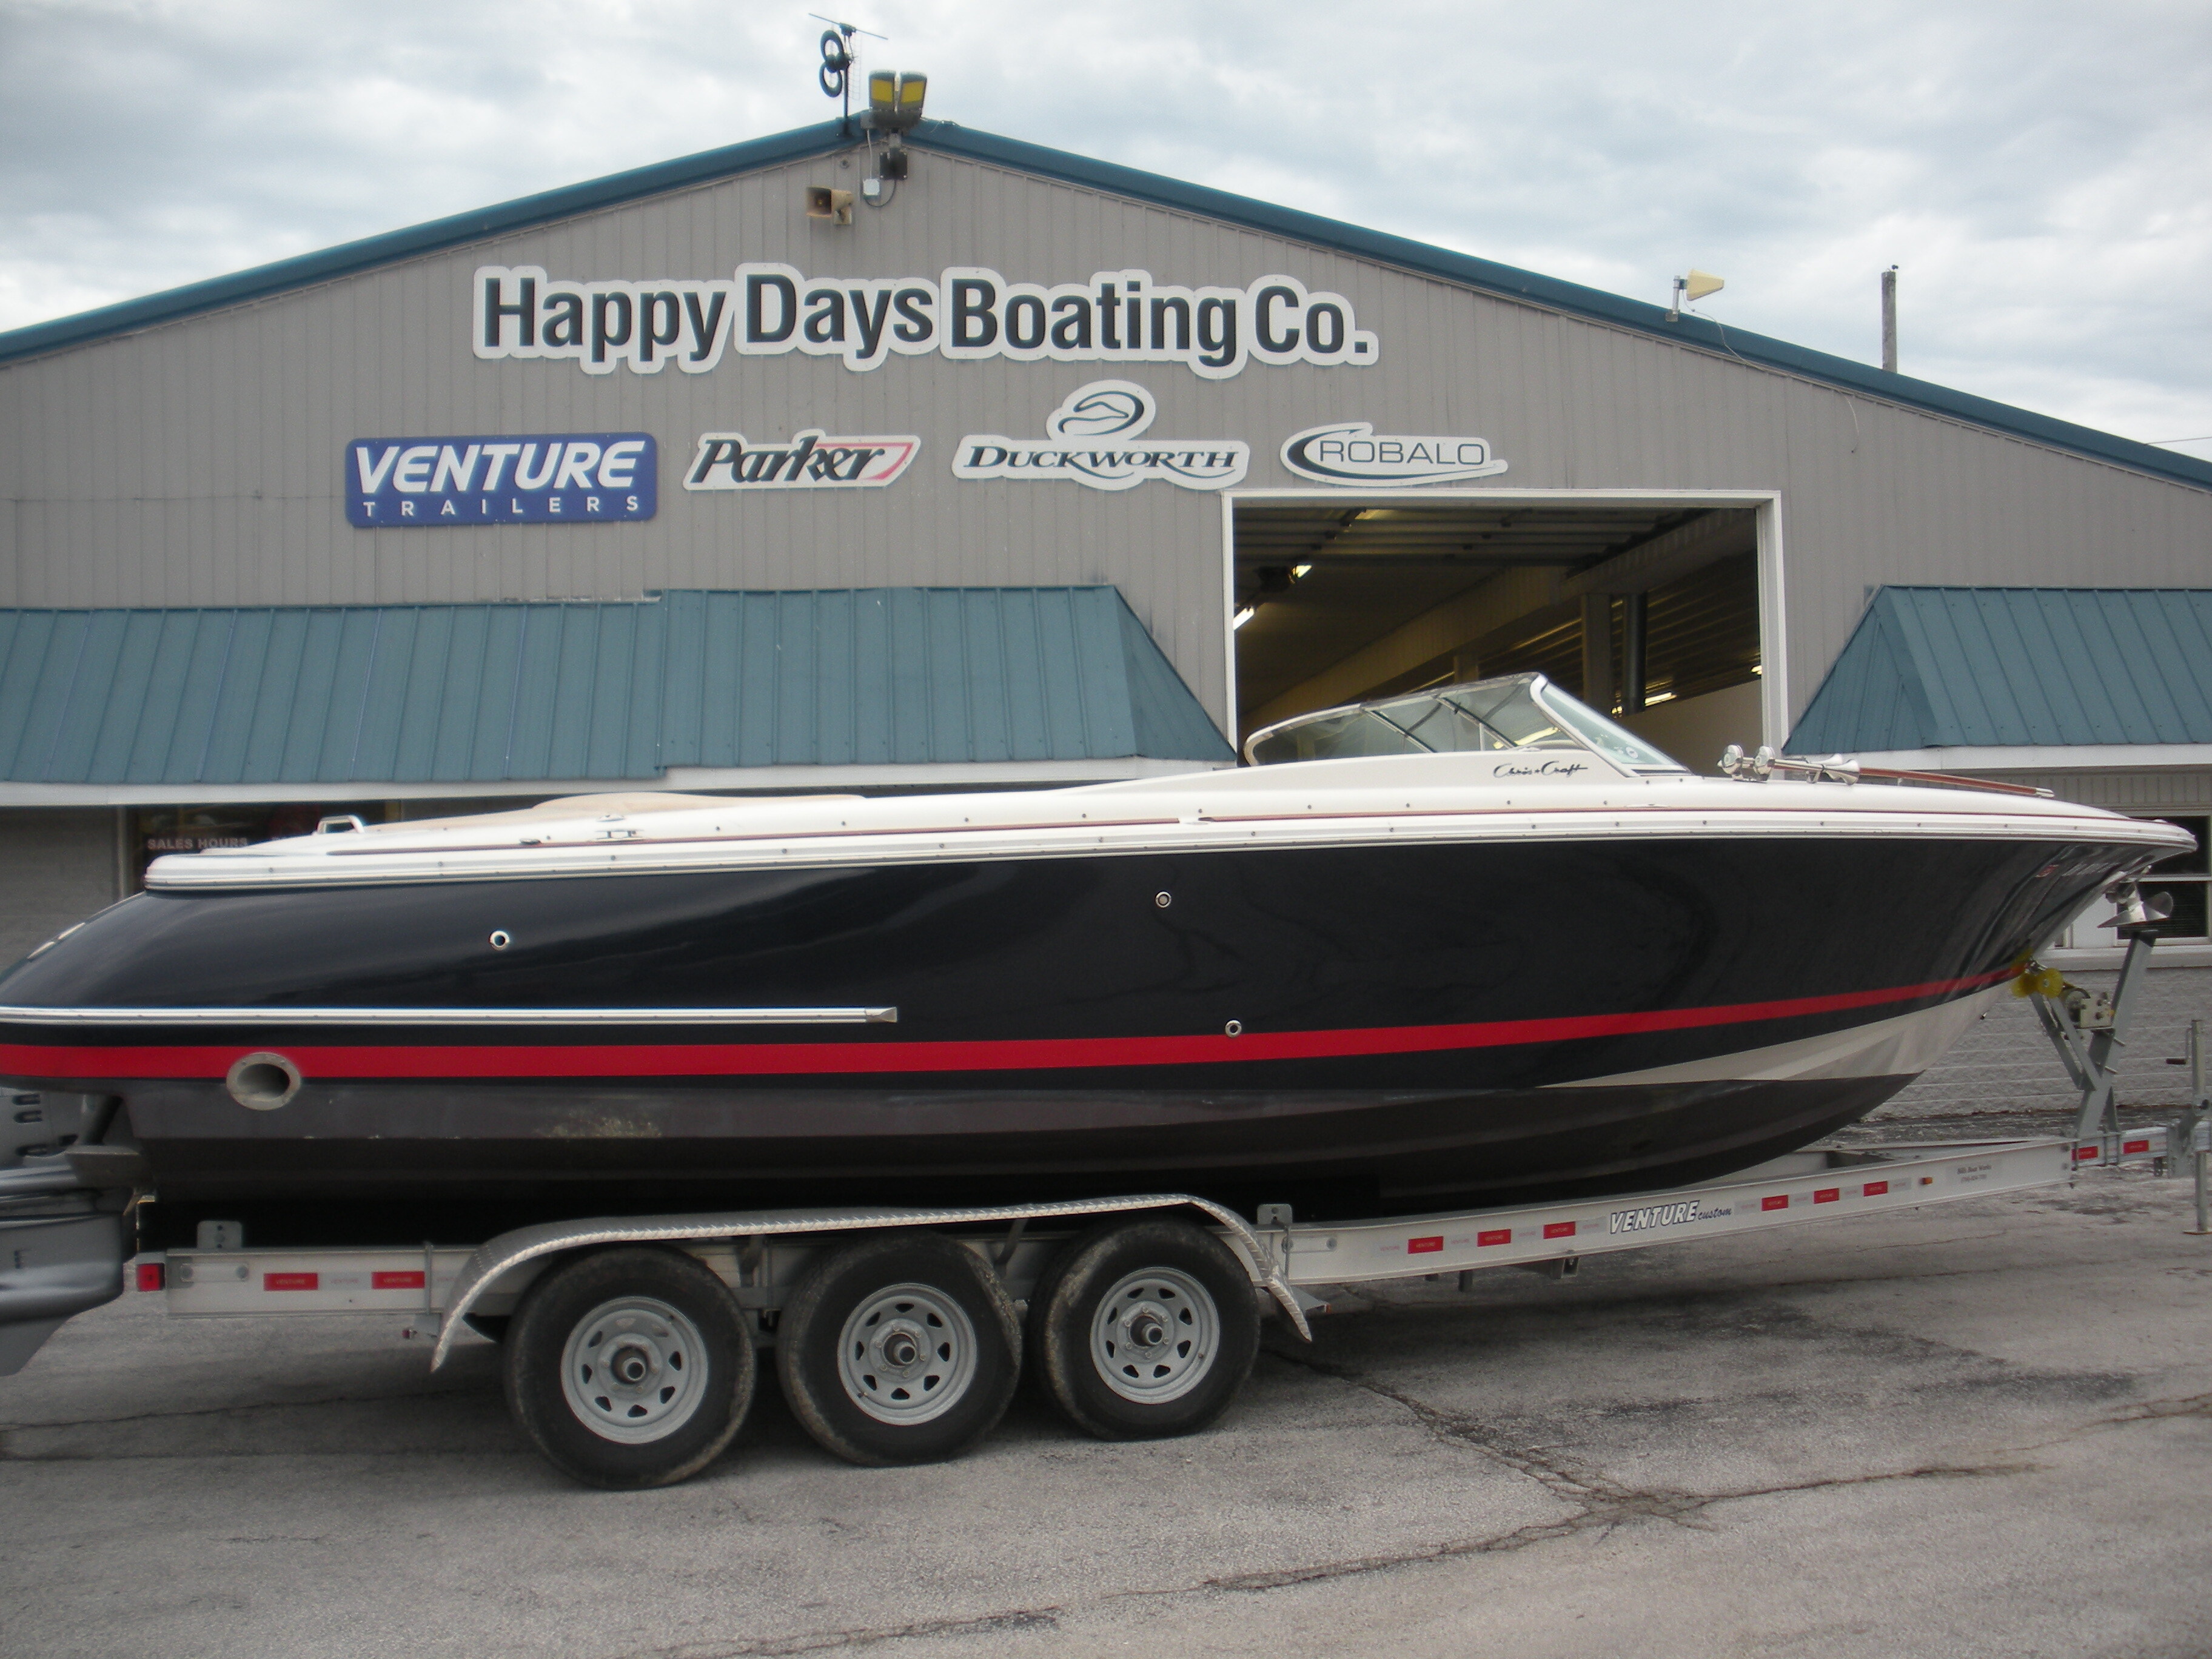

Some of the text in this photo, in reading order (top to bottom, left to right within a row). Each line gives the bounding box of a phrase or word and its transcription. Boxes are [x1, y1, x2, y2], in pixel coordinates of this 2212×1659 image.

[484, 273, 1369, 367] Happy Days Boating Co.
[355, 440, 646, 494] VENTURE
[689, 435, 886, 484] Parker
[963, 445, 1239, 479] DUCKWORTH
[1319, 440, 1486, 466] ROBALO
[363, 495, 640, 518] TRAILERS
[147, 836, 248, 850] SALES HOURS
[1610, 1200, 1732, 1235] VENTURE custom
